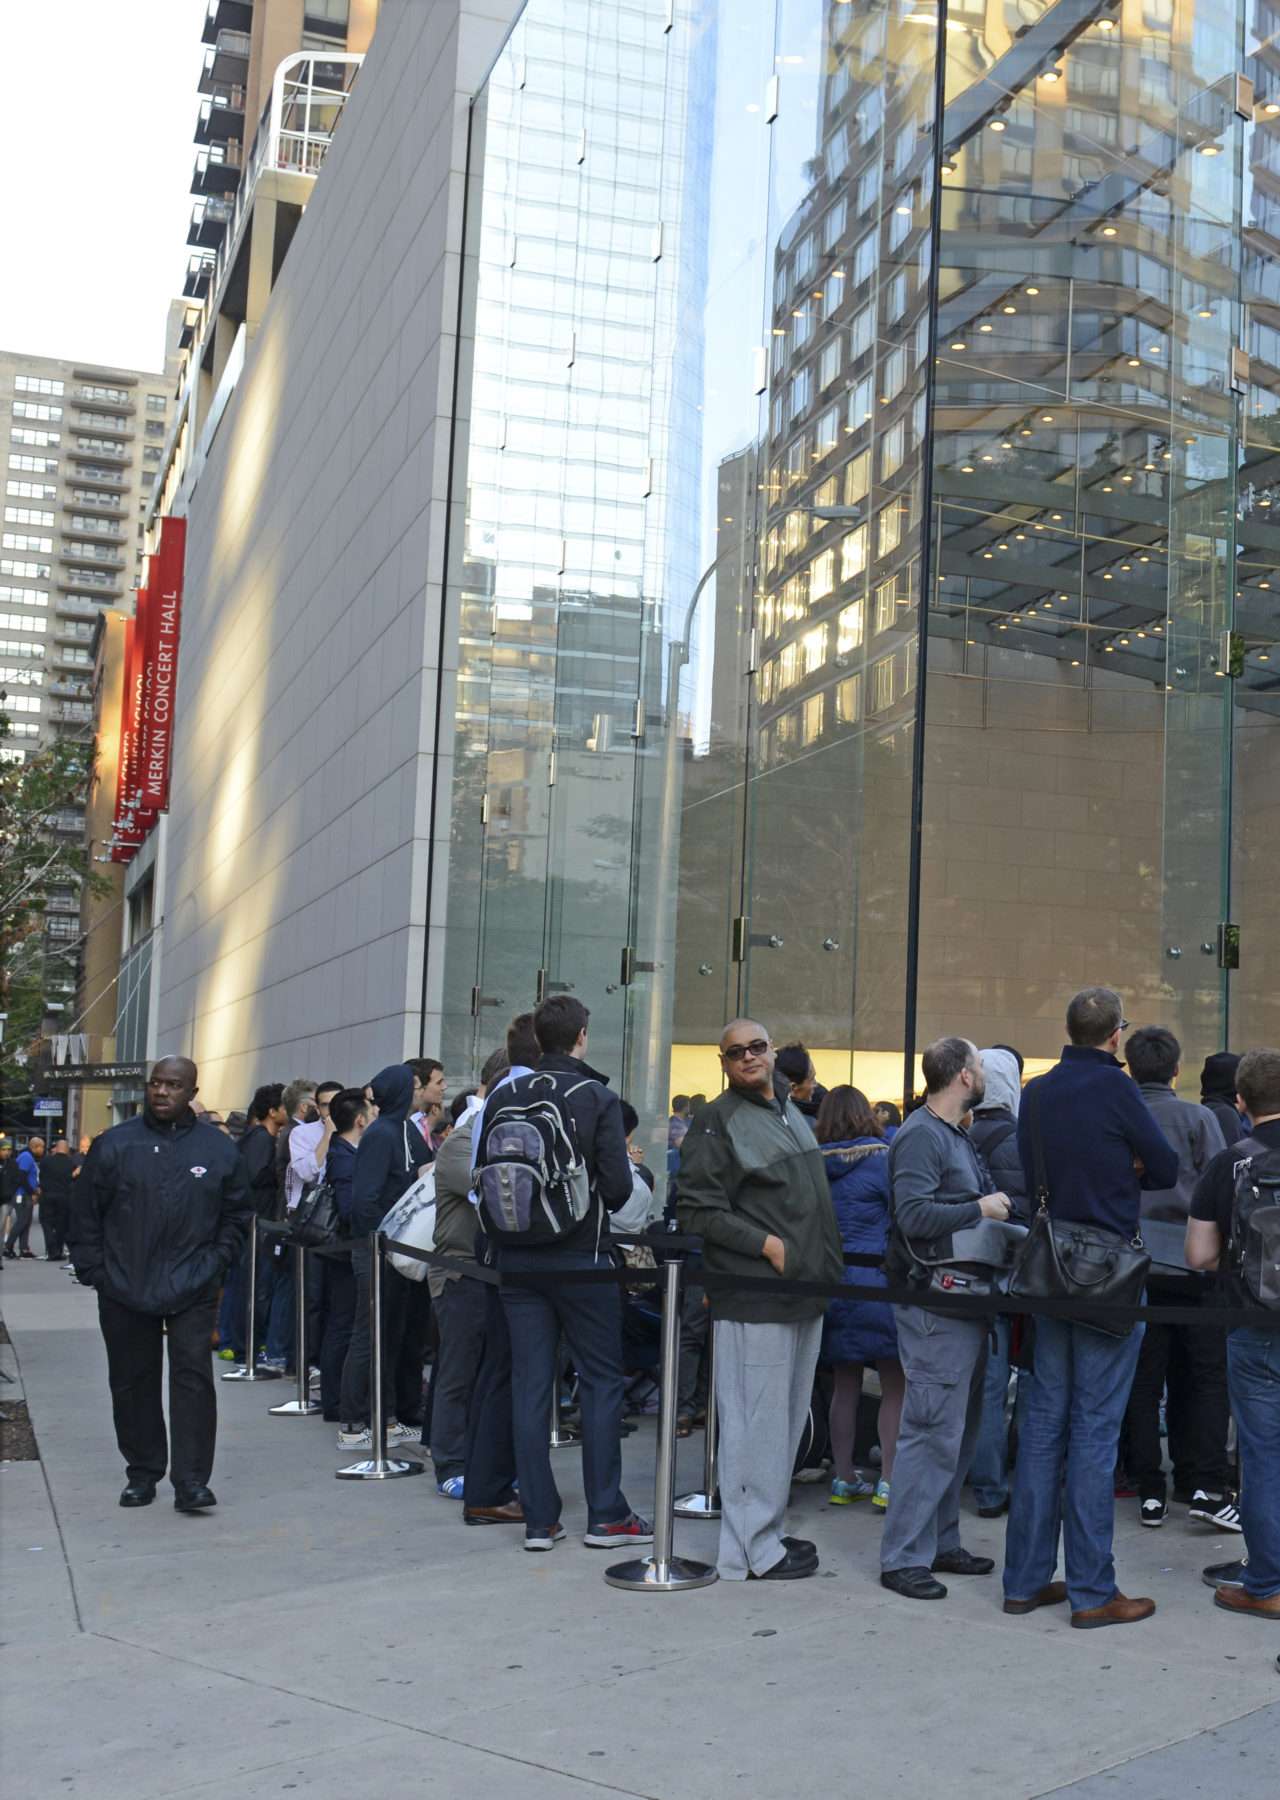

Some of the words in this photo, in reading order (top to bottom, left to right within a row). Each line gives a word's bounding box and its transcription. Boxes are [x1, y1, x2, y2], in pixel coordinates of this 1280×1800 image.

[160, 590, 177, 634] HALL
[153, 640, 173, 722] CONCERT
[147, 729, 167, 796] MERKIN
